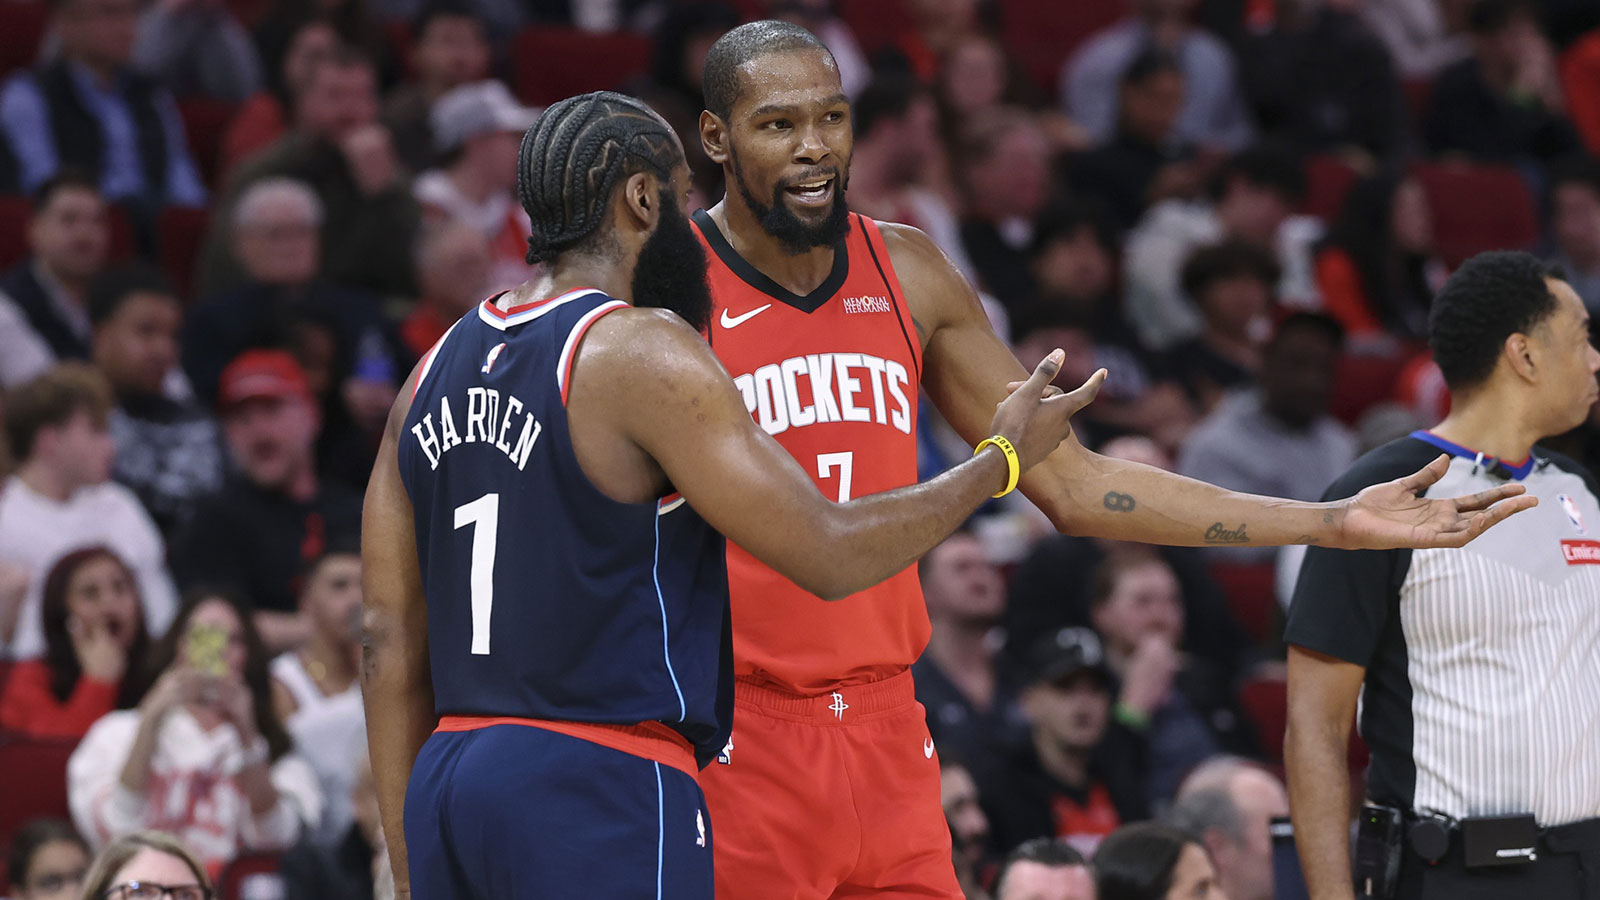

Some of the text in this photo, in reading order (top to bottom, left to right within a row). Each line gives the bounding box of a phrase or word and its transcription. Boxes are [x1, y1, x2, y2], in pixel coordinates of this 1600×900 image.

[842, 295, 889, 306] MEMORIAL
[844, 303, 890, 314] HERMANN
[411, 387, 542, 471] HARDEN
[817, 451, 853, 503] 7
[1204, 521, 1250, 544] Owls
[454, 493, 499, 655] 1
